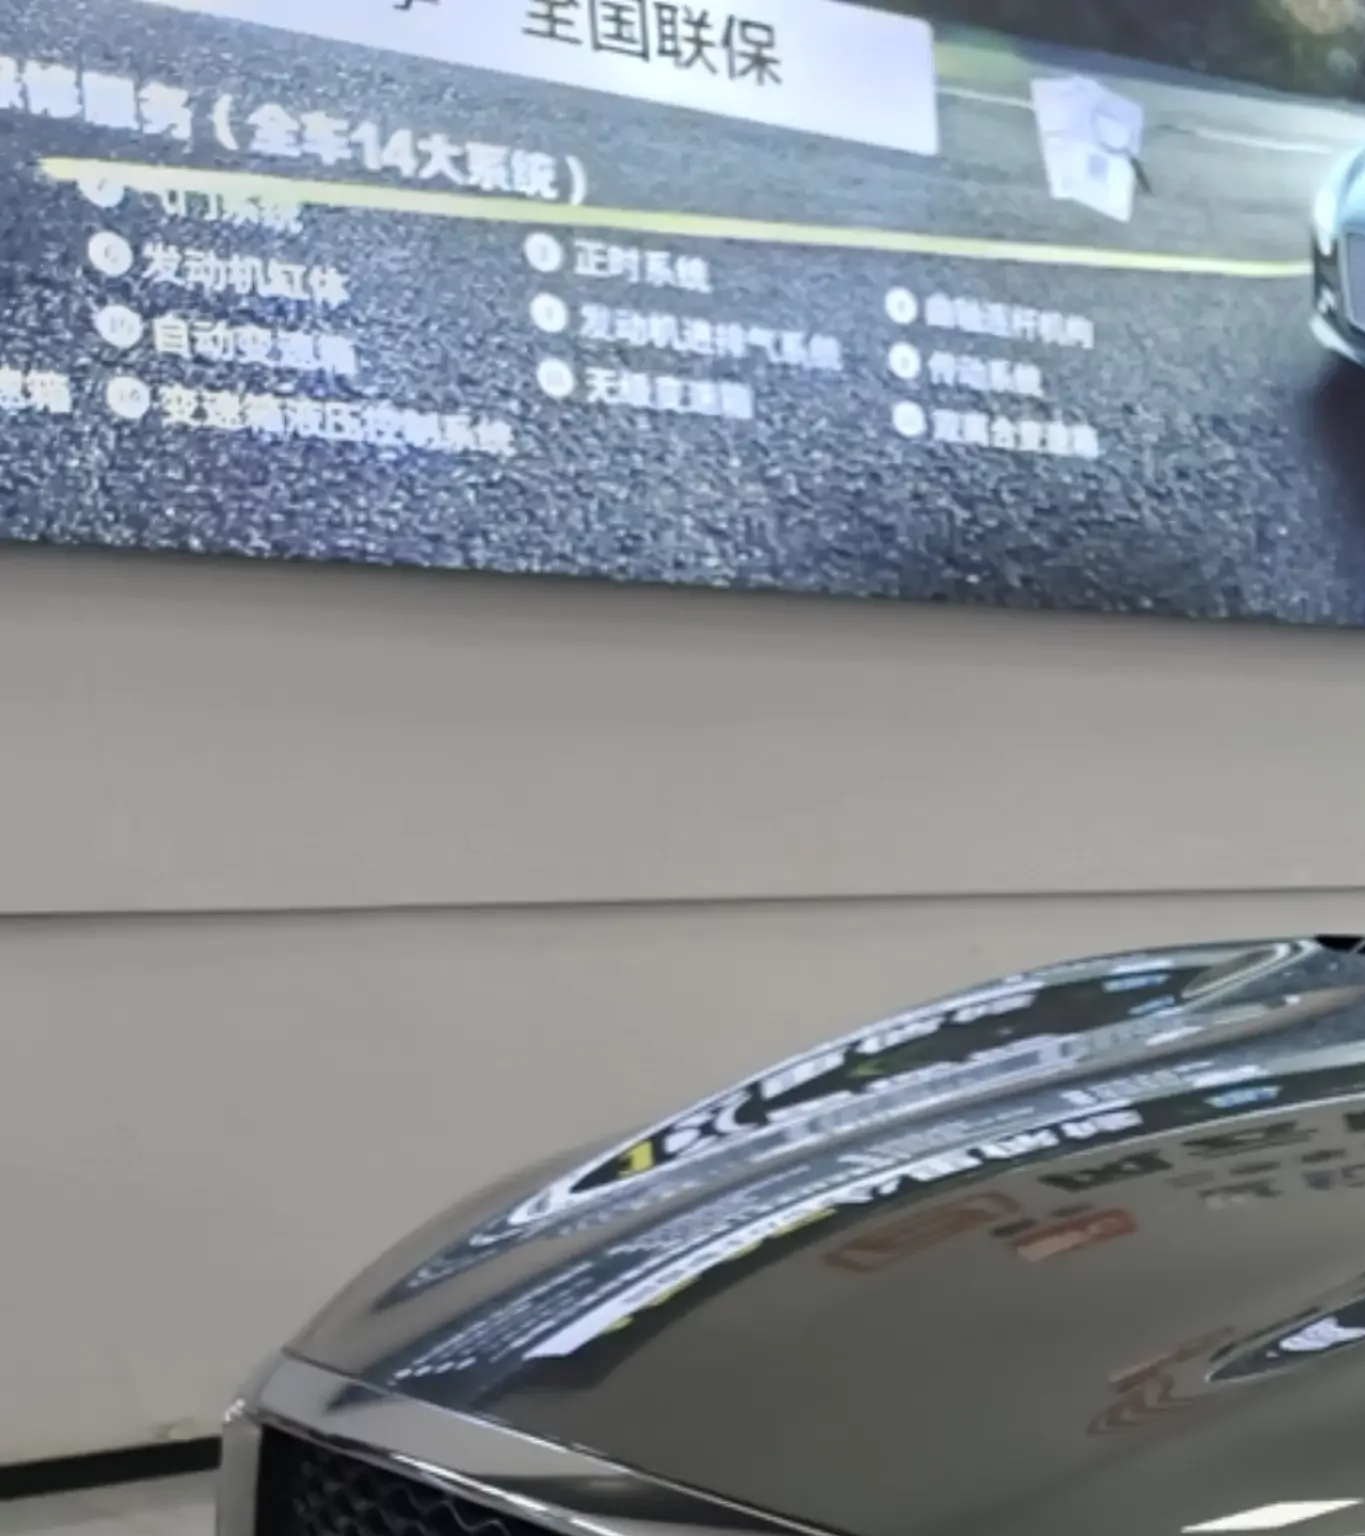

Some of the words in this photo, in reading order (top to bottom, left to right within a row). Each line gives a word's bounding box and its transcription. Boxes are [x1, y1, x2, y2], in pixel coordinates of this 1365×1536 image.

[521, 0, 783, 86] 全国联保
[142, 240, 350, 307] 发动机缸体
